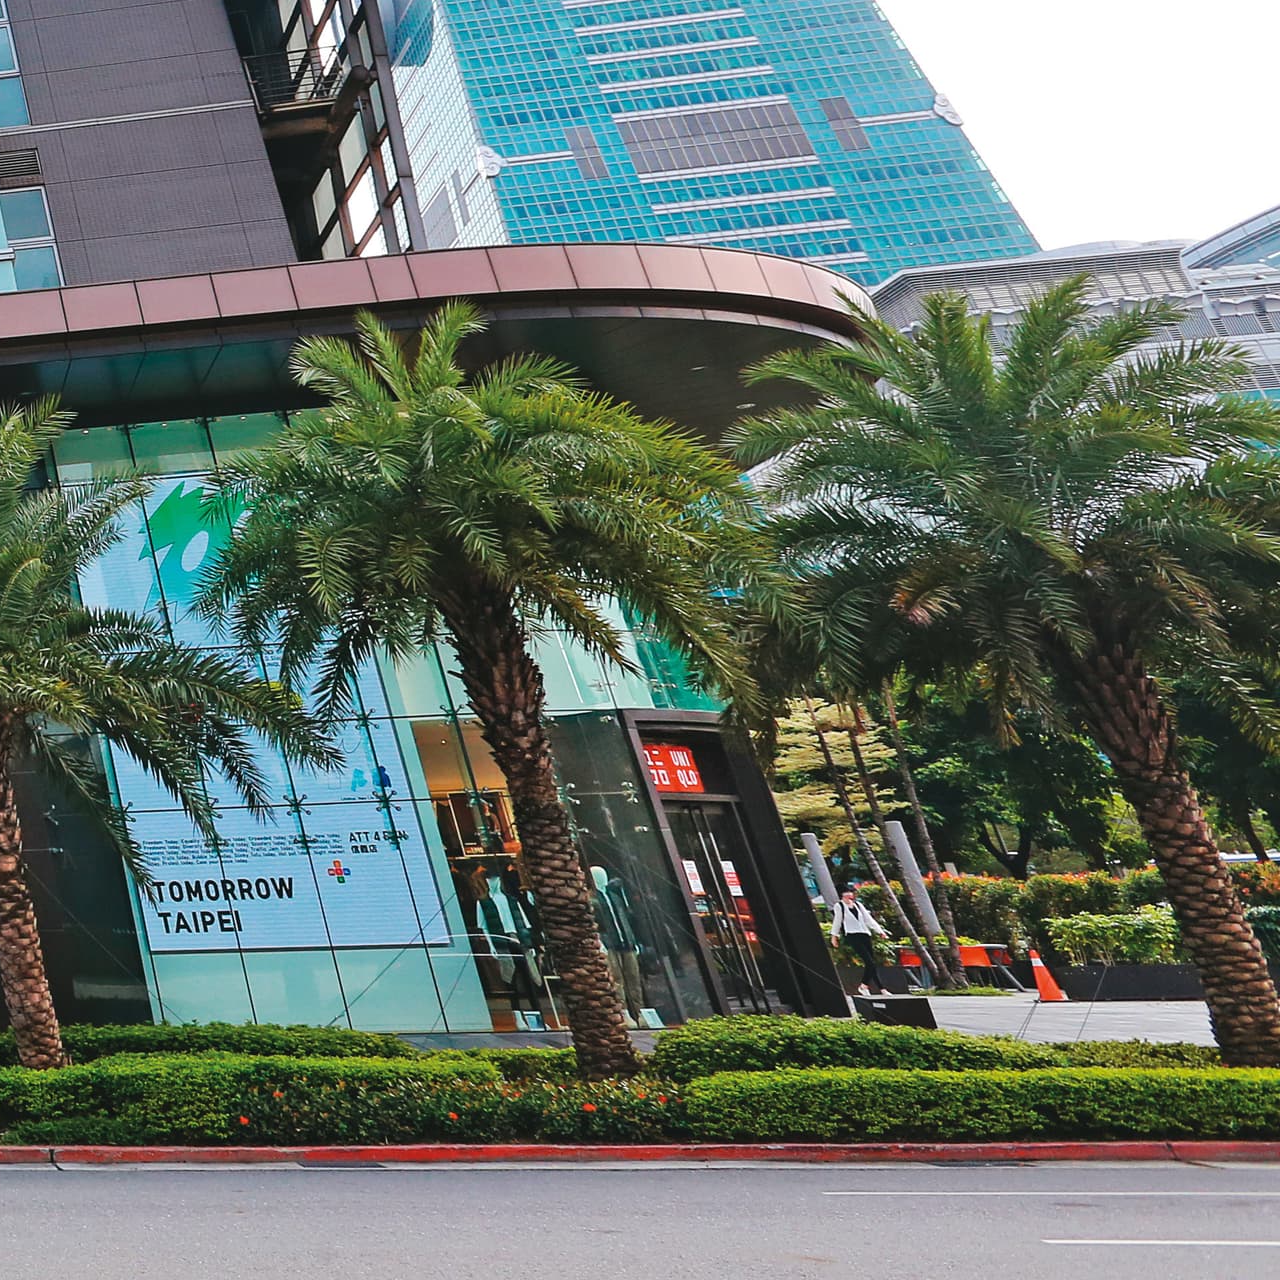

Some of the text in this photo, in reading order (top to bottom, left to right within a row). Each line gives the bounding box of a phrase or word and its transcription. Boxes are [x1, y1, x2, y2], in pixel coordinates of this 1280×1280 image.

[669, 750, 690, 767] UNI
[676, 770, 698, 788] QLO
[349, 831, 370, 842] ATT
[151, 877, 293, 902] TOMORROW
[157, 910, 243, 934] TAIPEI
